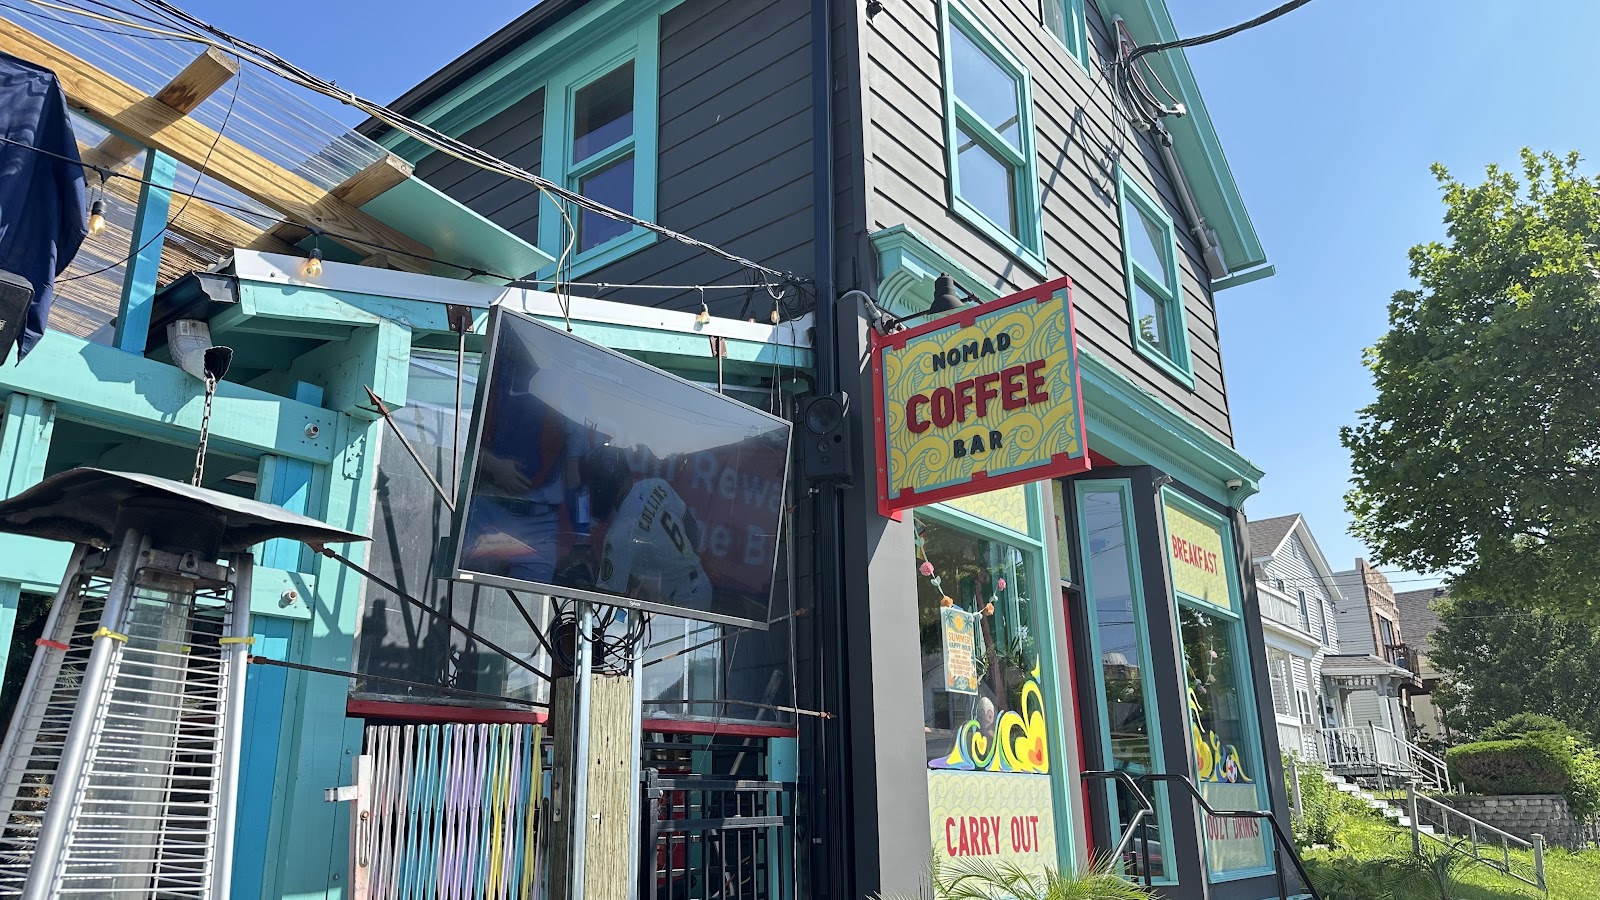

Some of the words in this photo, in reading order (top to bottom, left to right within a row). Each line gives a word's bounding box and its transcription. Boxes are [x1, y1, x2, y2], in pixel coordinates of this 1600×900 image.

[932, 332, 1011, 372] NOMAD
[905, 358, 1049, 434] COFFEE
[953, 430, 1003, 459] BAR
[638, 485, 668, 533] COLLINS
[660, 509, 686, 554] 6
[1171, 534, 1218, 576] BREAKFAST
[948, 631, 971, 645] SUMMER
[949, 641, 961, 650] HAPPY
[961, 643, 971, 652] HOUR
[945, 815, 1001, 857] CARRY
[1010, 815, 1039, 853] OUT
[1232, 814, 1259, 839] DRINKS
